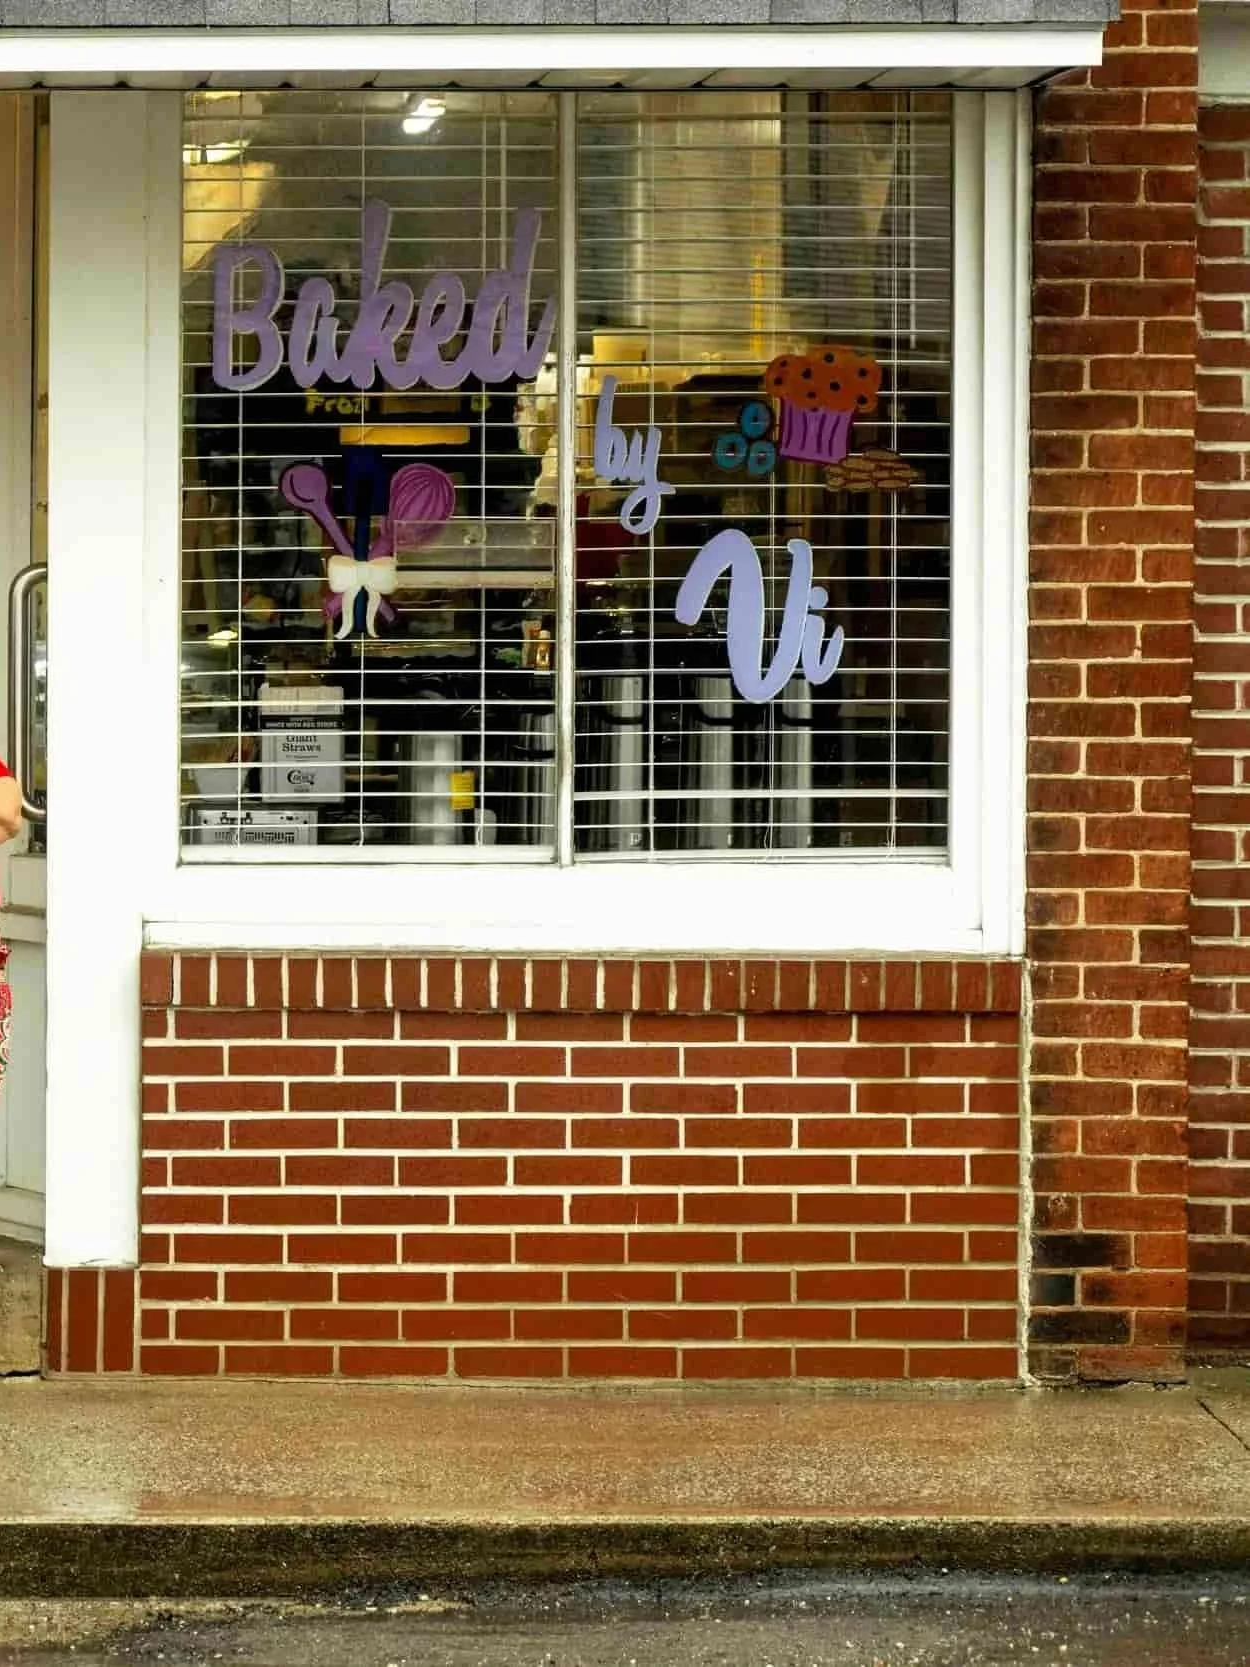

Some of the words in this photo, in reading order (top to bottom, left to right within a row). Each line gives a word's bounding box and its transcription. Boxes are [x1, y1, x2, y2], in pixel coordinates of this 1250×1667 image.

[212, 199, 557, 391] Baked
[595, 375, 676, 535] by
[674, 528, 845, 705] Vi
[282, 743, 322, 753] Straws
